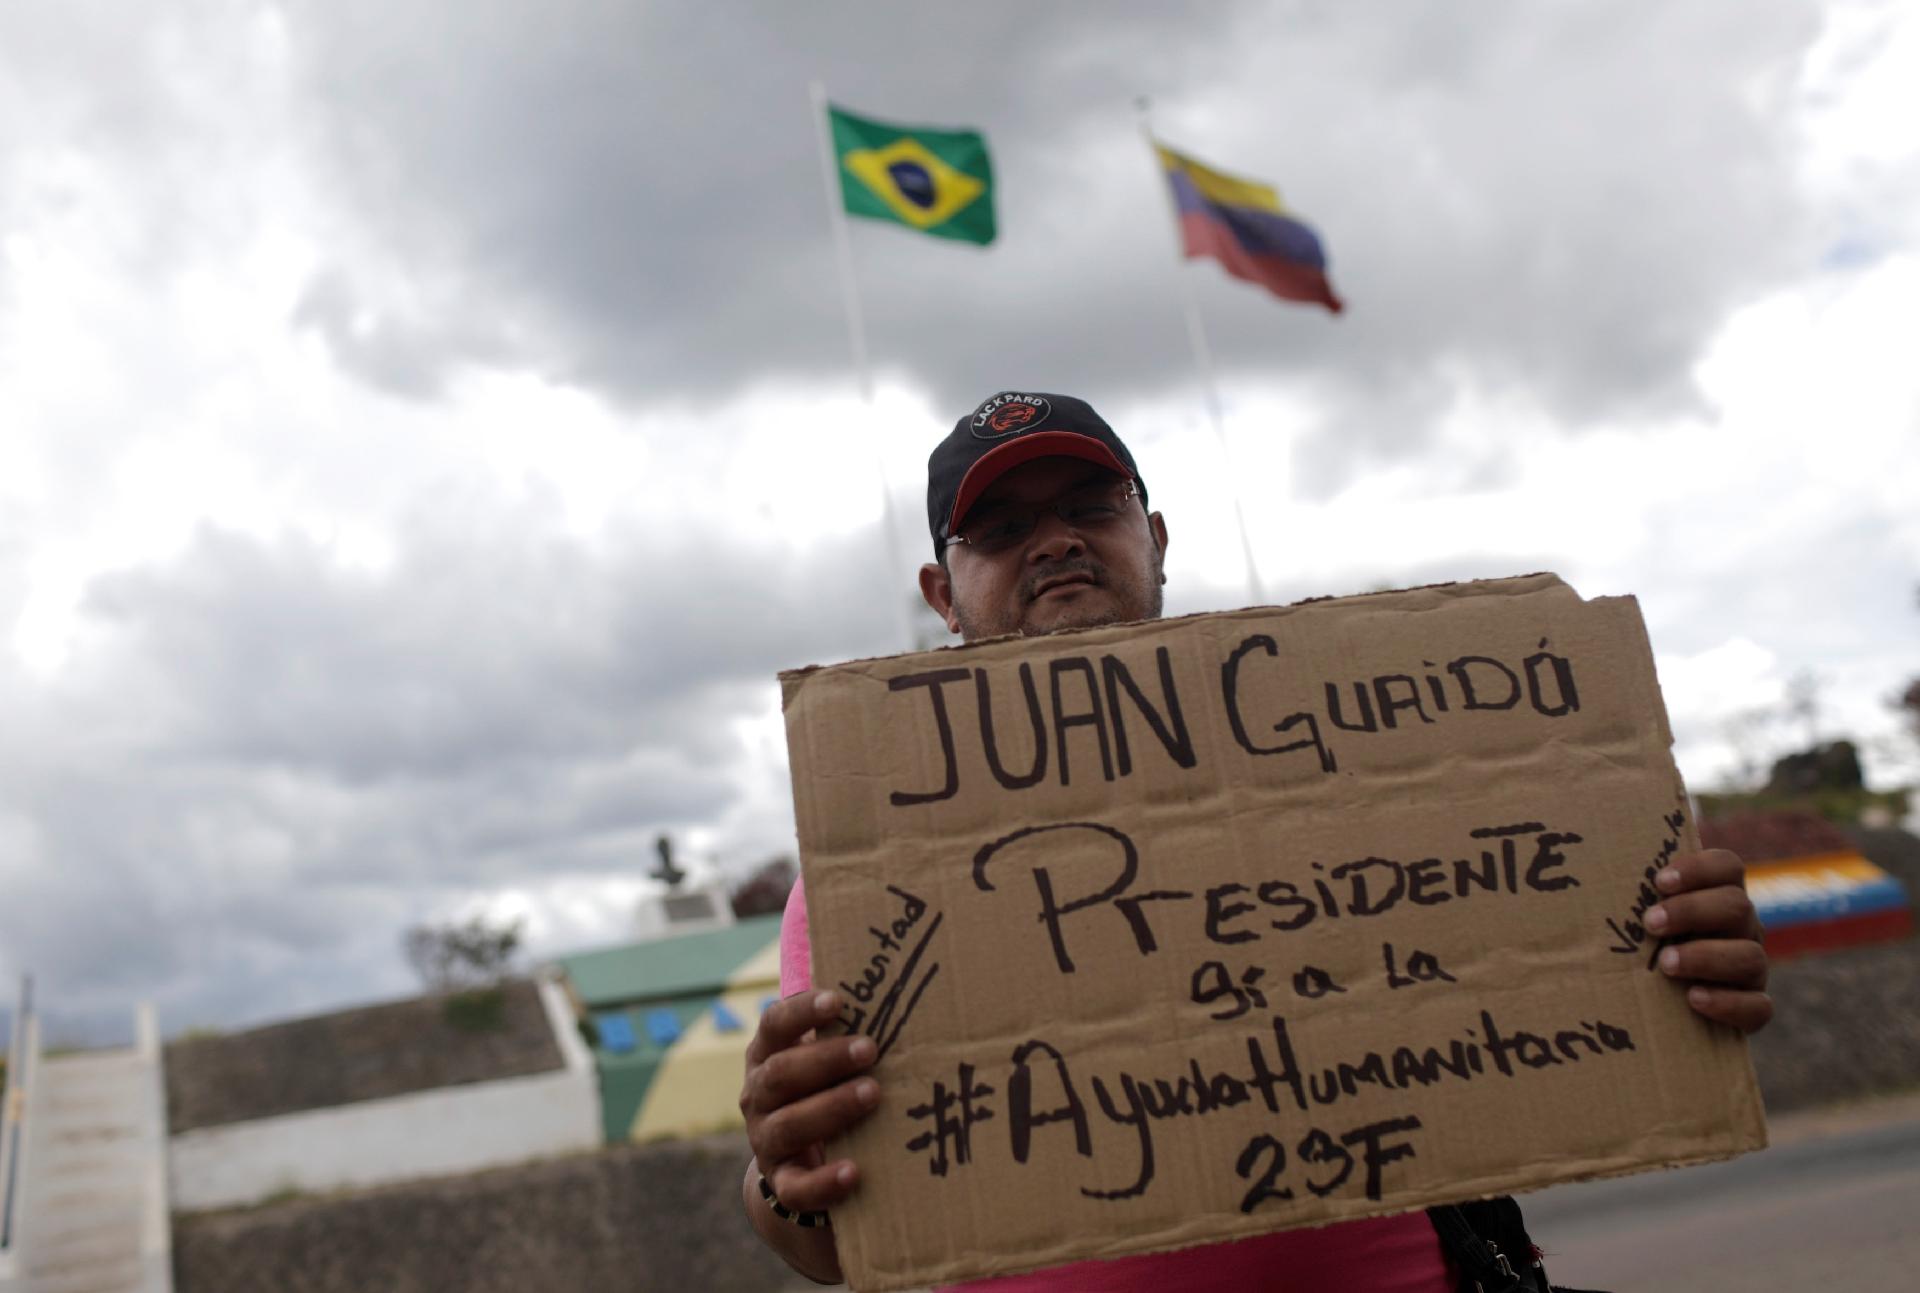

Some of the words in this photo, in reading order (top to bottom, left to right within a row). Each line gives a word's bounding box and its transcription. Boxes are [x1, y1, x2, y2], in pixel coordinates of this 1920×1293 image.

[887, 646, 1197, 807] JUAN
[1292, 964, 1348, 999] a
[1235, 1114, 1422, 1214] 23F
